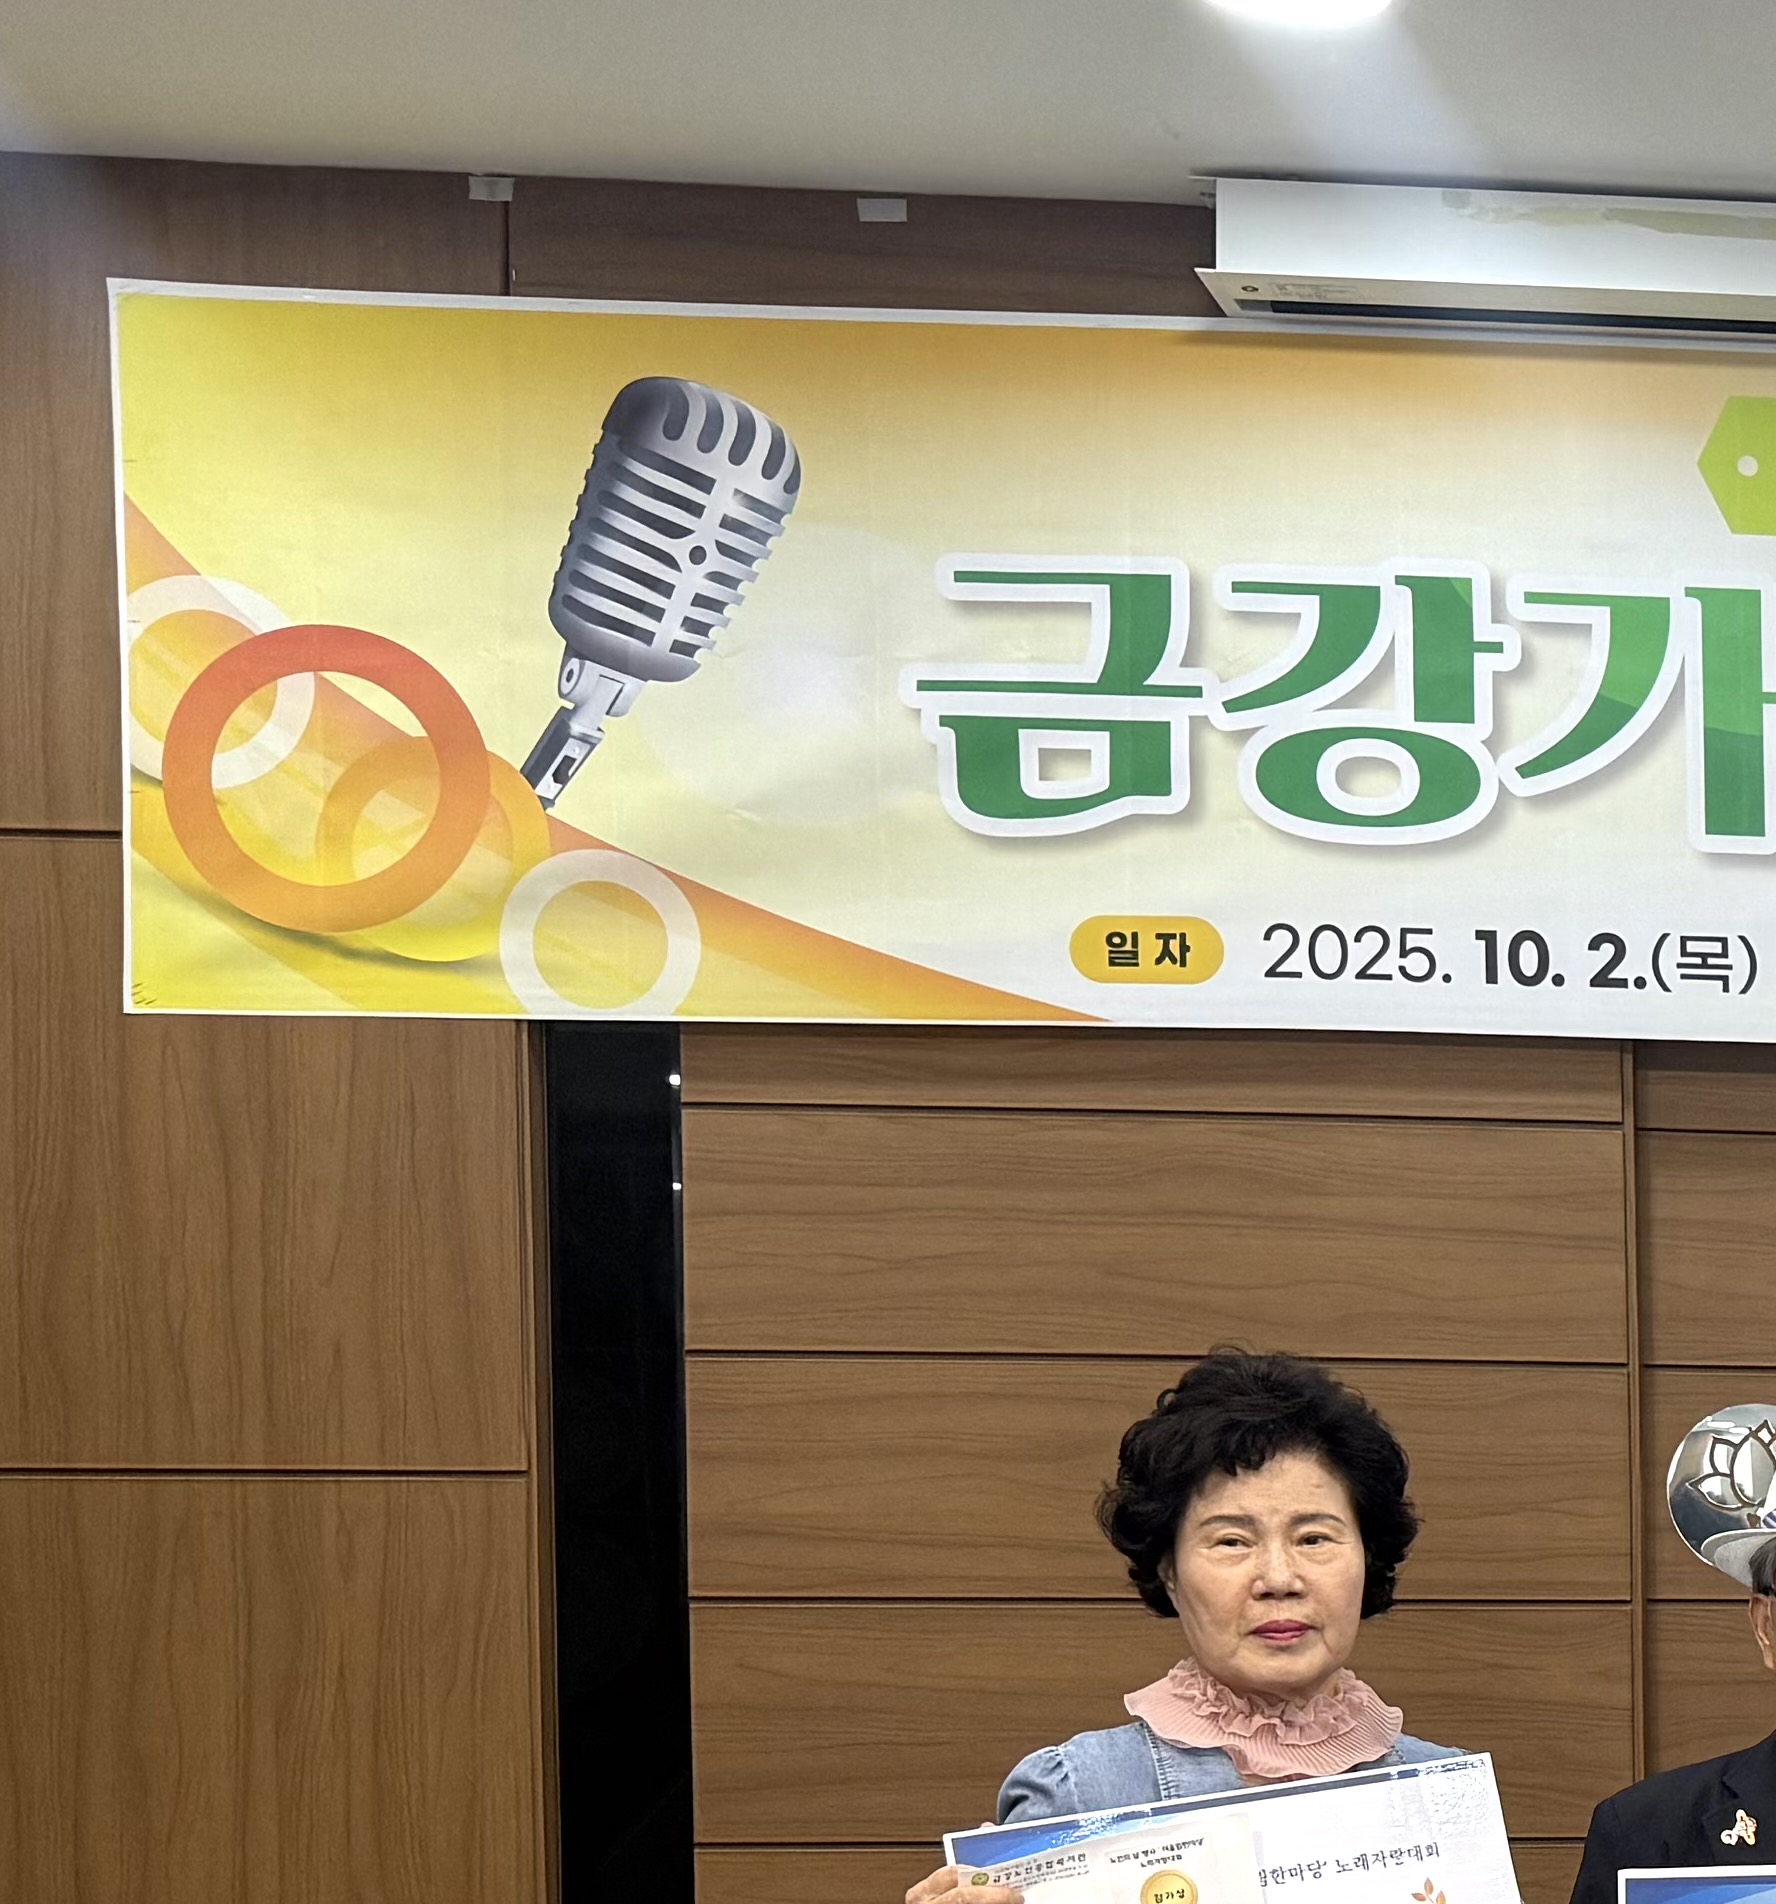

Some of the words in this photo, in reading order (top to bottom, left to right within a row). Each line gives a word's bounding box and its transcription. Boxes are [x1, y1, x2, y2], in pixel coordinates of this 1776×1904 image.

[1263, 922, 1452, 984] 2025.
[1475, 928, 1566, 987] 10.
[1335, 1841, 1441, 1875] 노래자랑대회
